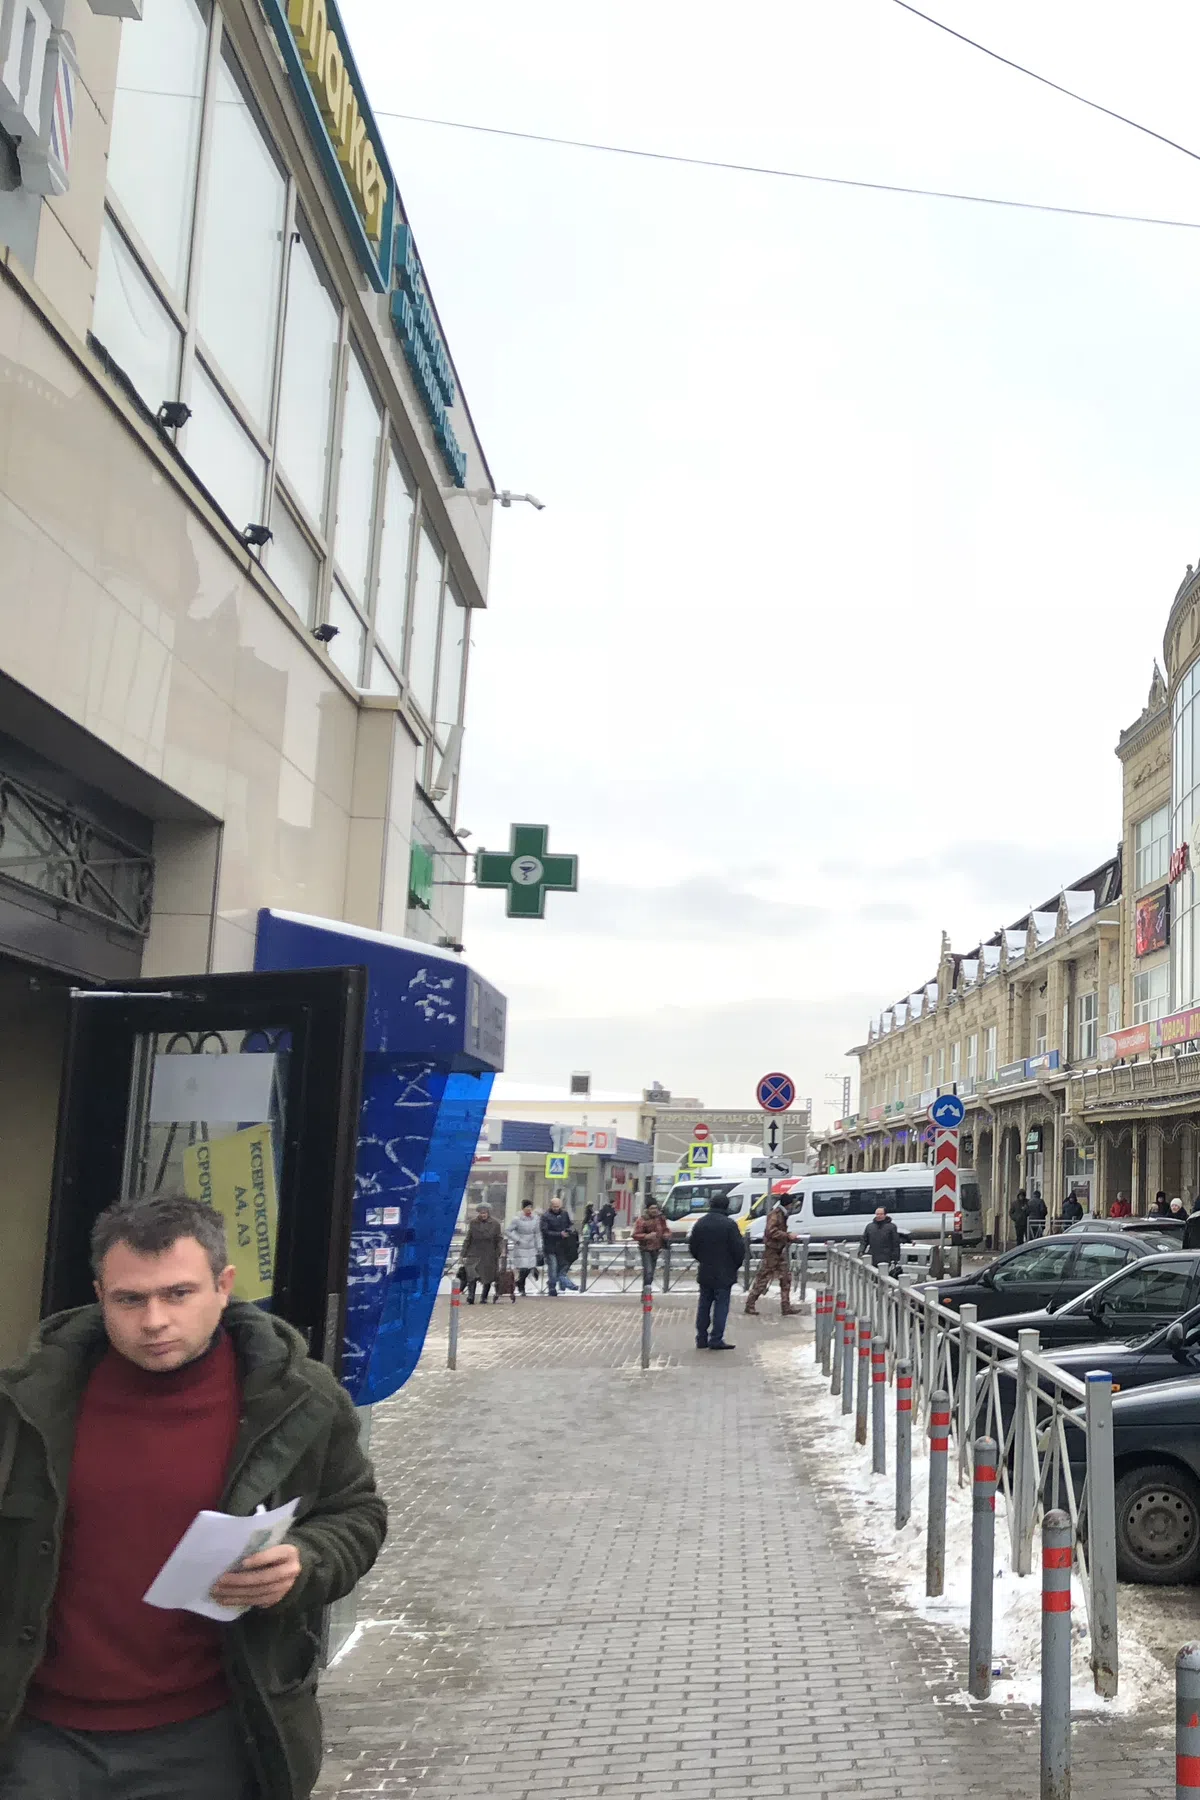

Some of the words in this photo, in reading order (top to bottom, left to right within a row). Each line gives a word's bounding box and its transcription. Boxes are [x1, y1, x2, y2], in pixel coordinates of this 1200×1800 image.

[1160, 1014, 1186, 1040] ТОВАРЫ
[197, 1146, 212, 1206] СРОЧ
[234, 1185, 248, 1217] А4,
[250, 1140, 274, 1283] КСЕРОКОПИЯ
[237, 1221, 251, 1248] А3
